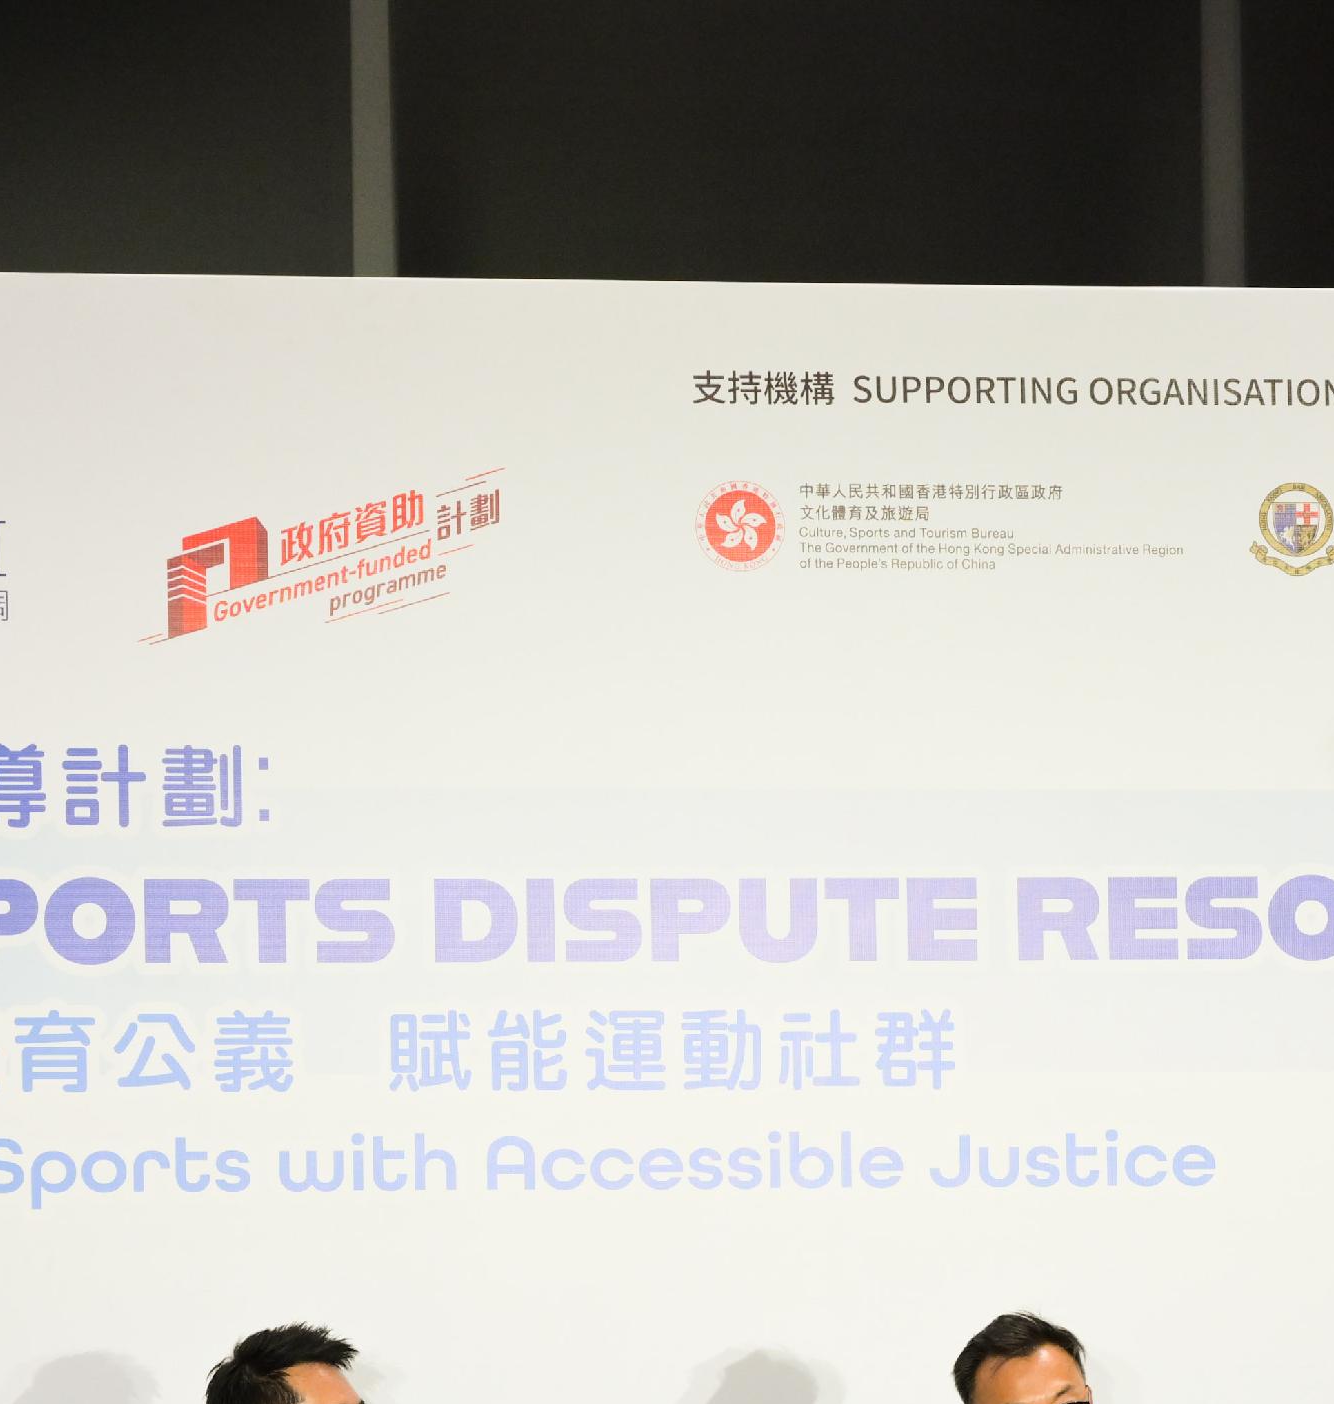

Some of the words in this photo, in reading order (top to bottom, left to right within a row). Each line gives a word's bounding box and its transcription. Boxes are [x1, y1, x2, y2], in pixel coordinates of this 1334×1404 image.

[692, 370, 835, 406] 支持機構
[853, 375, 1079, 405] SUPPORTING
[799, 484, 1063, 500] 中華人民共和國香港特別行政區政府
[280, 489, 424, 566] 政府資助
[436, 488, 500, 541] 計劃
[800, 505, 929, 521] 文化體育及旅遊局
[799, 527, 847, 540] Culture,
[849, 527, 890, 540] Sports
[894, 527, 916, 538] and
[920, 528, 967, 538] Tourism
[971, 528, 1014, 539] Bureau
[800, 542, 821, 553] The
[825, 542, 898, 553] Government
[901, 542, 913, 553] of
[916, 542, 935, 553] the
[938, 543, 970, 557] Hong
[974, 543, 1004, 556] Kong
[1008, 543, 1051, 557] Special
[1054, 544, 1139, 555] Administrative
[1143, 544, 1184, 557] Region
[213, 538, 432, 622] Government-funded
[799, 557, 811, 569] of
[814, 558, 833, 569] the
[837, 558, 887, 571] People's
[891, 558, 944, 571] Republic
[946, 558, 958, 569] of
[961, 558, 996, 570] China
[329, 564, 447, 616] programme
[433, 876, 978, 965] DISPUTE
[389, 1008, 956, 1092] 賦能運動社群
[278, 1133, 458, 1193] with
[485, 1130, 904, 1193] Accessible
[929, 1129, 1217, 1190] Justice
